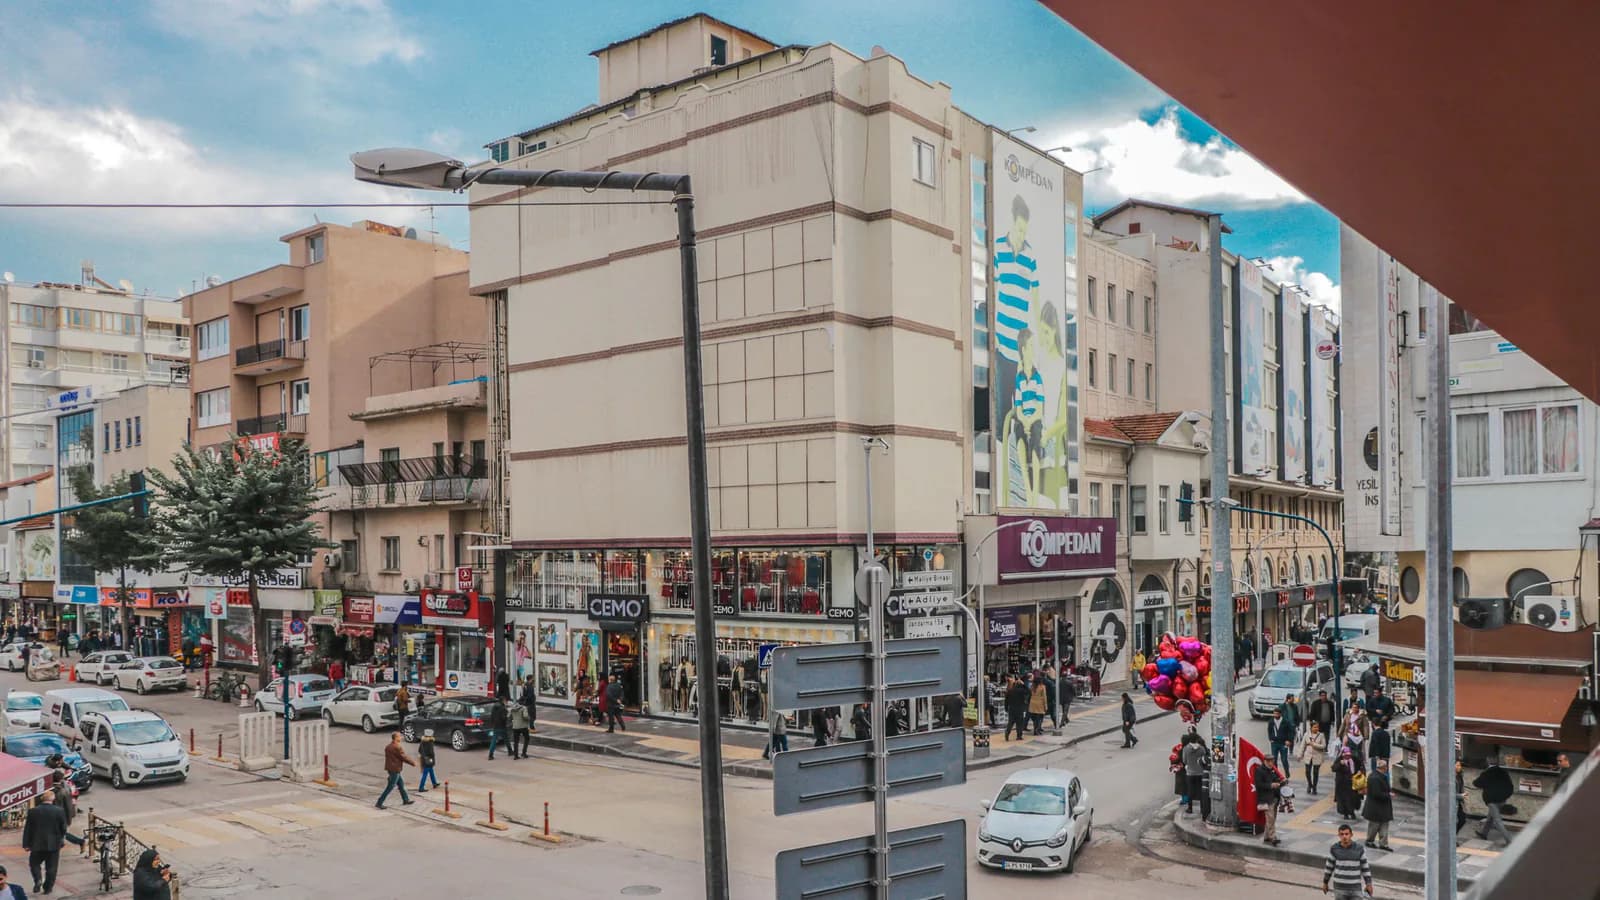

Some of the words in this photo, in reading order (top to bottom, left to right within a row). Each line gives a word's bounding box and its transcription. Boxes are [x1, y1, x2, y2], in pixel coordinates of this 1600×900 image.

[1004, 155, 1053, 191] KOMPEDAN
[1021, 525, 1101, 562] KOMPEDAN
[590, 599, 642, 617] CEMO
[915, 595, 948, 605] Adliye
[1236, 596, 1250, 613] FLO
[828, 608, 854, 618] CEMO
